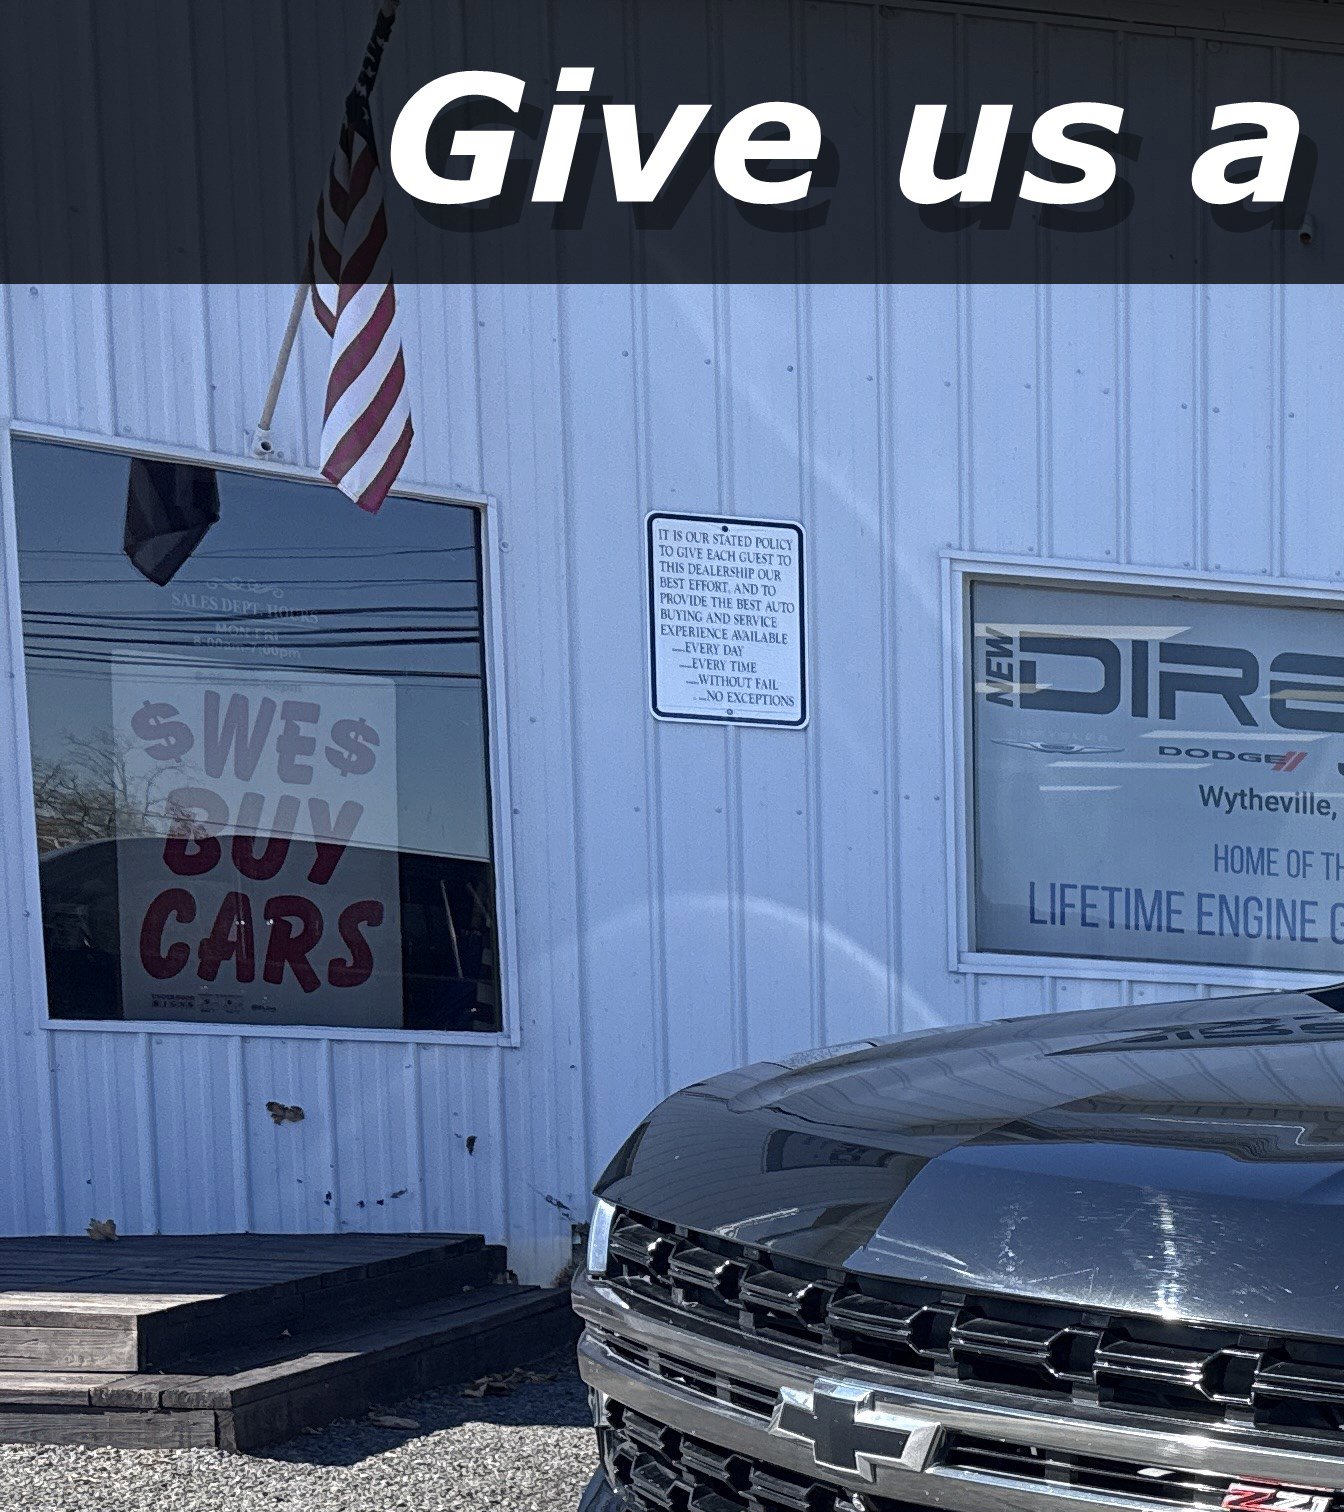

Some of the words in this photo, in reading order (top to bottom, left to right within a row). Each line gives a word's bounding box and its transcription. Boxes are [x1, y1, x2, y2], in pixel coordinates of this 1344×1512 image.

[659, 529, 669, 540] IT
[674, 530, 682, 541] IS
[686, 531, 709, 544] OUR
[713, 534, 752, 547] STATED
[756, 537, 793, 550] POLICY
[659, 545, 673, 557] TO
[677, 546, 702, 559] GIVE
[707, 549, 735, 562] EACH
[739, 552, 774, 565] GUEST
[778, 554, 791, 566] TO
[659, 561, 684, 573] THIS
[688, 563, 754, 579] DEALERSHIP
[758, 569, 781, 581] OUR
[660, 577, 685, 589] BEST
[734, 583, 758, 595] AND
[762, 585, 776, 596] TO
[660, 593, 707, 607] PROVIDE
[711, 597, 732, 609] THE
[737, 598, 762, 611] BEST
[765, 601, 794, 613] AUTO
[661, 608, 702, 622] BUYING
[706, 612, 730, 624] AND
[734, 614, 777, 628] SERVICE
[661, 624, 728, 639] EXPERIENCE
[732, 630, 788, 645] AVAILABLE
[724, 645, 744, 656] DAY
[730, 660, 757, 673] TIME
[985, 625, 1014, 708] NEW
[756, 678, 778, 690] FAIL
[727, 691, 794, 706] EXCEPTIONS
[1158, 745, 1288, 764] DODGE
[1199, 784, 1337, 821] Wytheville,
[162, 787, 365, 886] BUY
[1214, 844, 1280, 877] HOME
[1286, 849, 1315, 879] OF
[1029, 881, 1185, 934] LIFETIME
[1197, 892, 1319, 943] ENGINE
[139, 887, 385, 994] CARS
